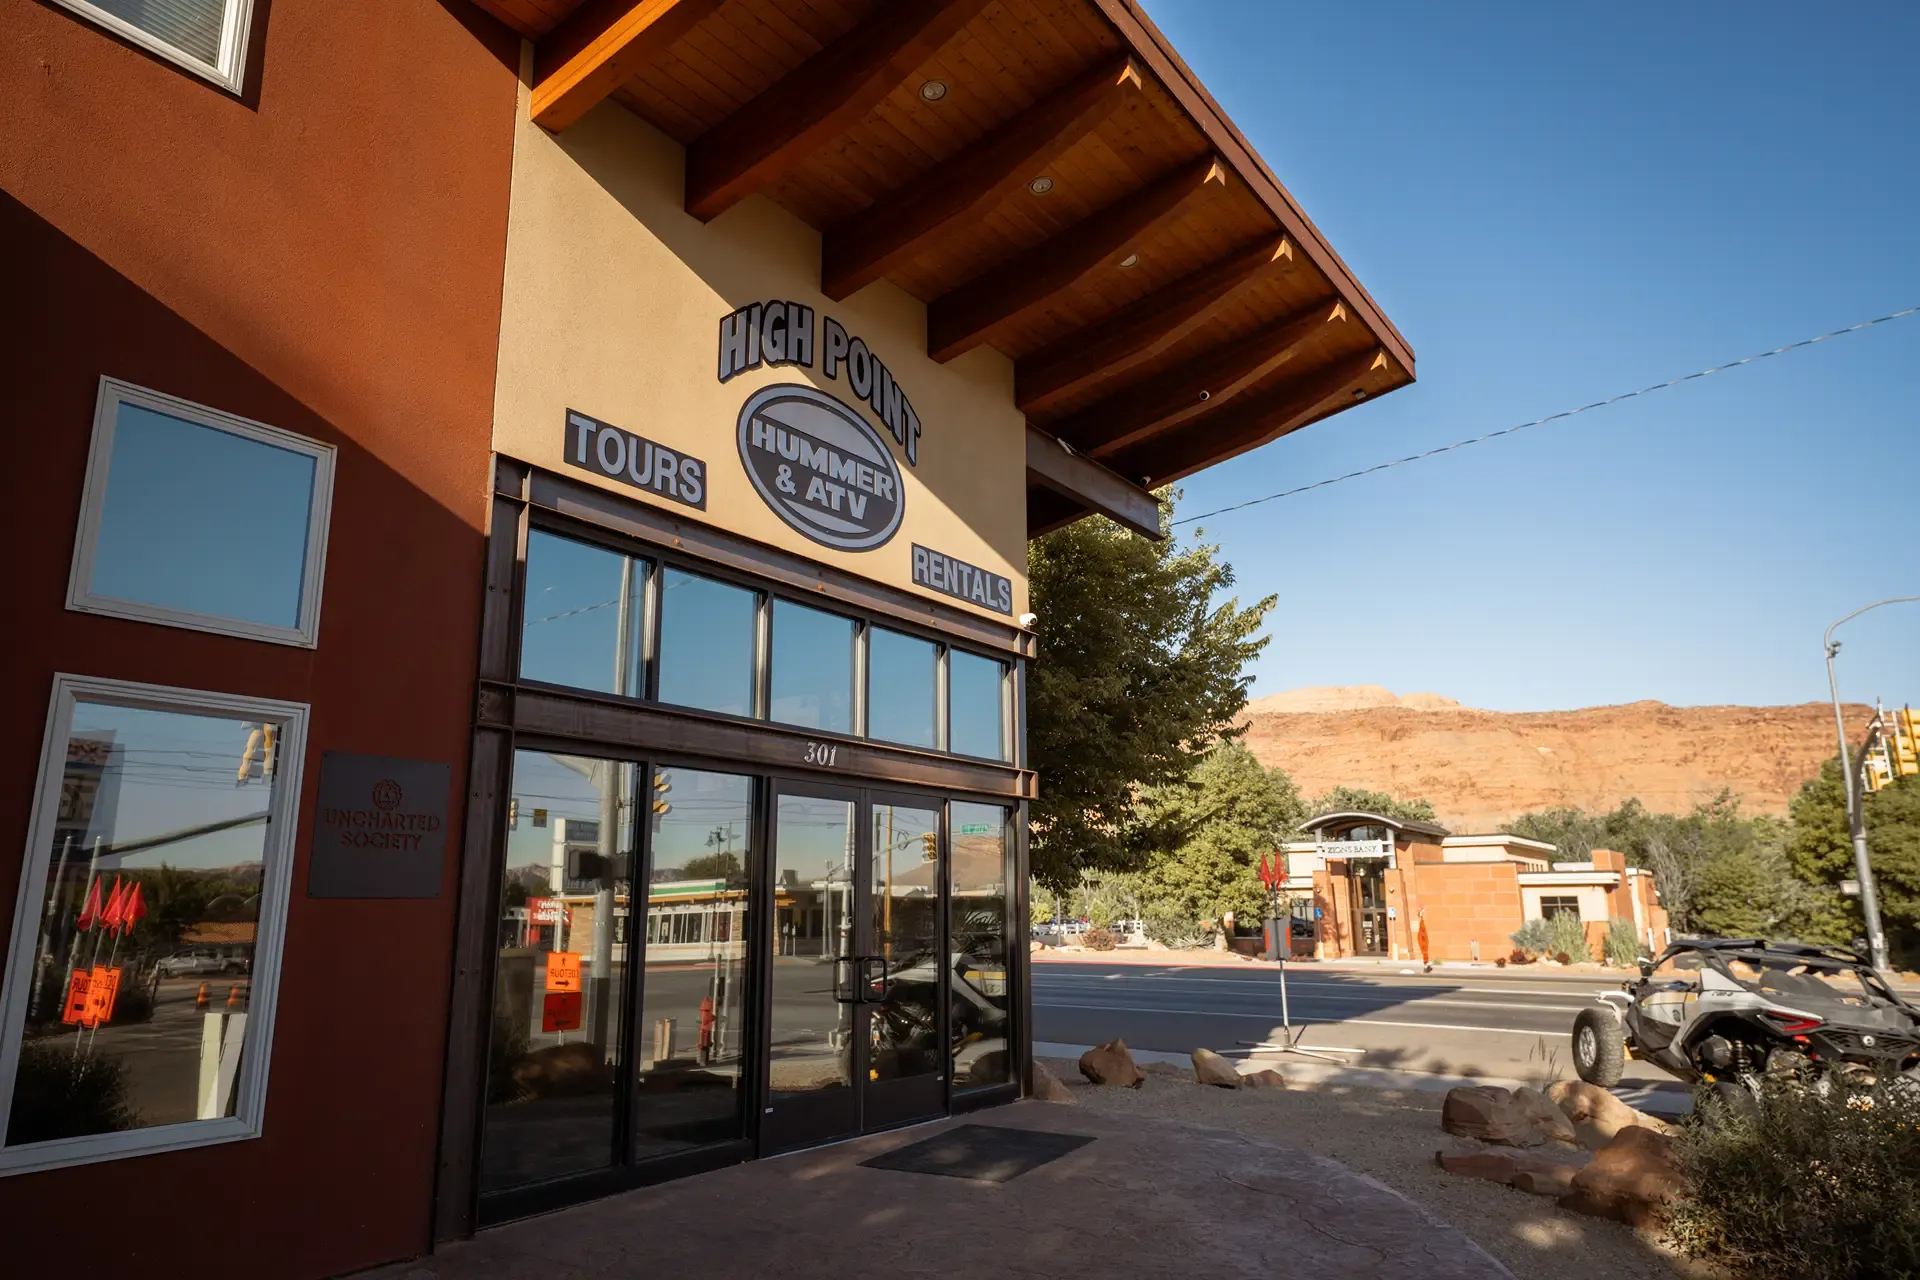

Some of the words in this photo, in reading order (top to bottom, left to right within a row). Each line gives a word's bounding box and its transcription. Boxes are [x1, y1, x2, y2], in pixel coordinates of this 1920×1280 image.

[717, 300, 815, 383] HIGH
[823, 316, 921, 467] POINT
[569, 413, 703, 505] TOURS
[752, 418, 894, 502] HUMMER
[775, 463, 797, 496] &
[806, 471, 868, 521] ATV
[912, 547, 1011, 613] RENTALS
[804, 741, 837, 767] 301
[324, 807, 441, 832] UNCHARTED
[340, 830, 423, 851] SOCIETY
[1327, 845, 1352, 854] ZIONS
[1354, 845, 1377, 853] BANK
